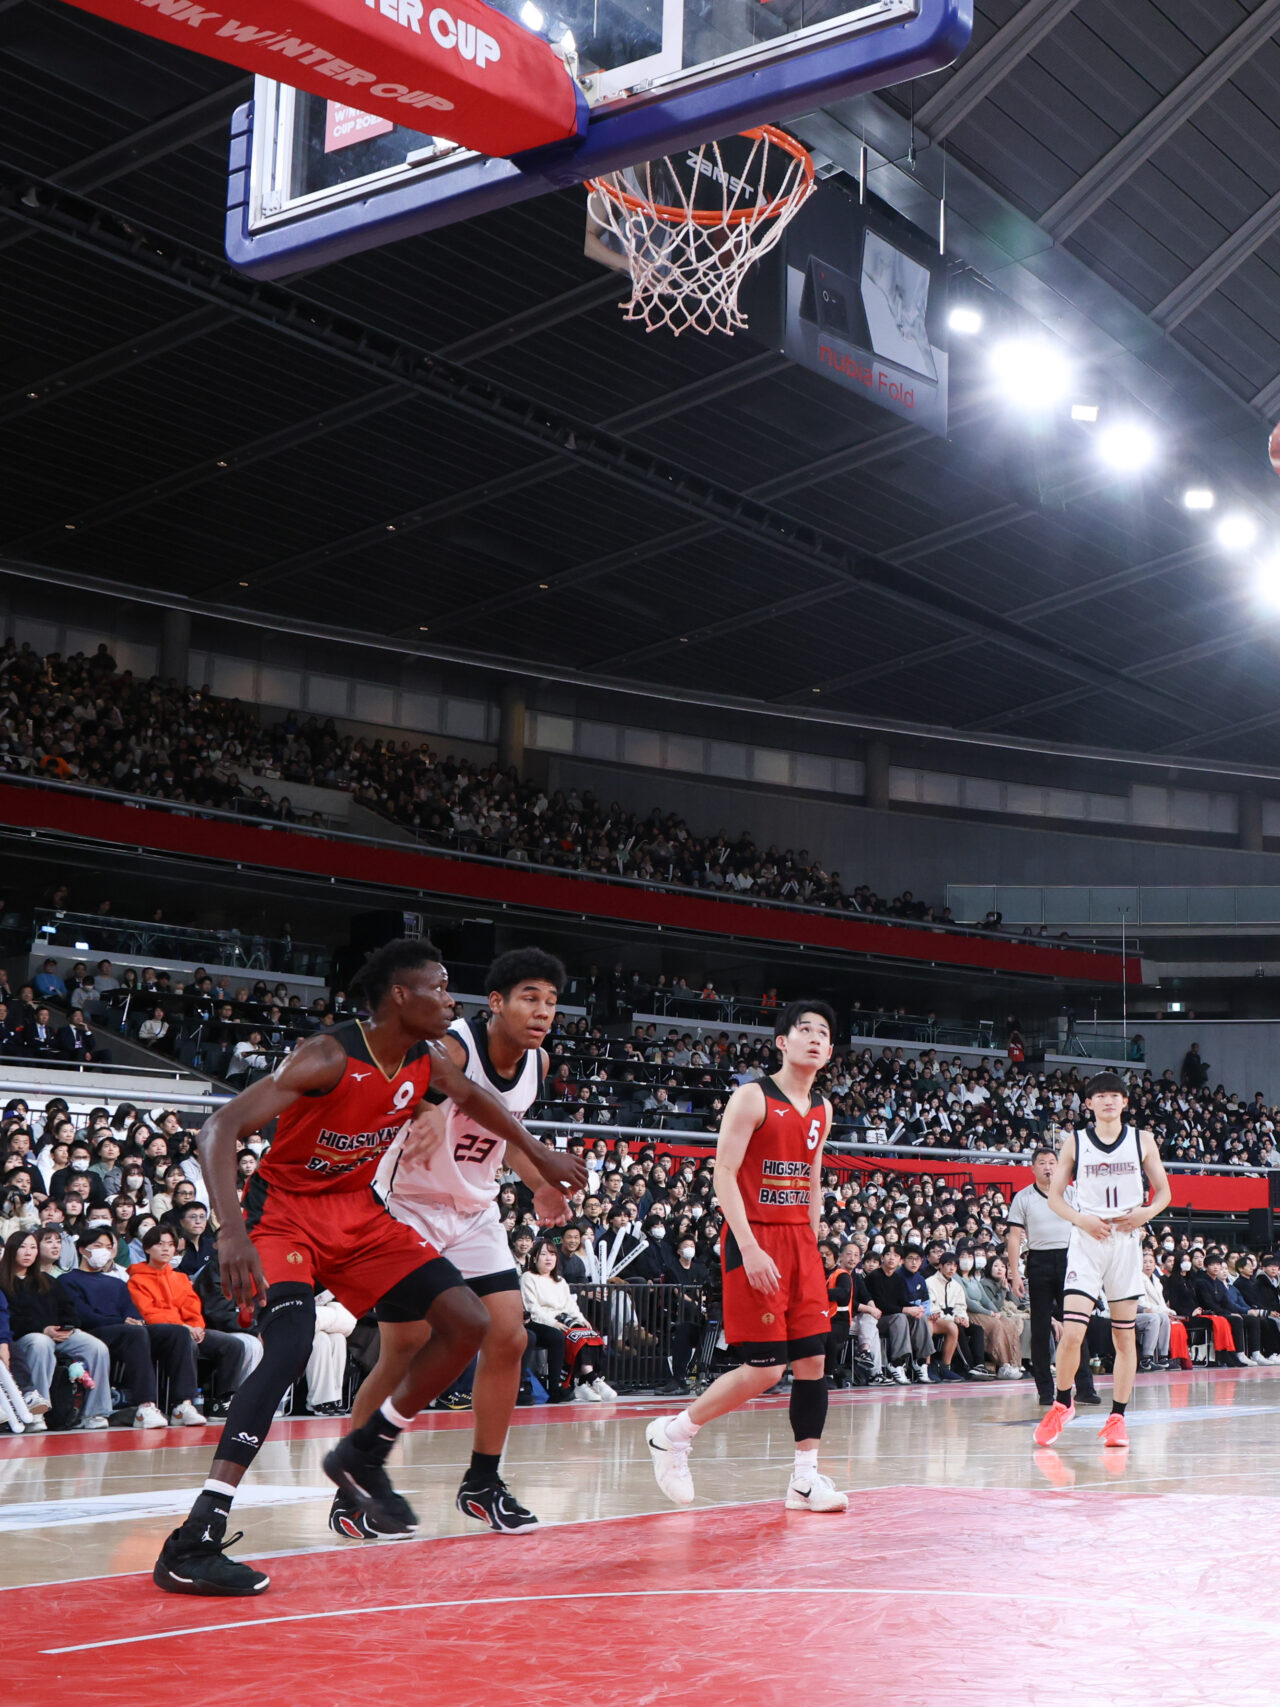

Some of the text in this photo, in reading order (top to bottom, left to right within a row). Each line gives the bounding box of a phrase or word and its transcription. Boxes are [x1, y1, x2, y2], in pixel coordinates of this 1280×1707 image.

[365, 0, 501, 69] ER CUP
[134, 0, 456, 111] NK WINTER CUP
[333, 121, 355, 137] CUP
[819, 344, 915, 409] nubia Fold
[386, 1080, 415, 1116] 9
[453, 1133, 498, 1164] 23
[806, 1119, 821, 1151] 5
[1105, 1186, 1118, 1208] 11
